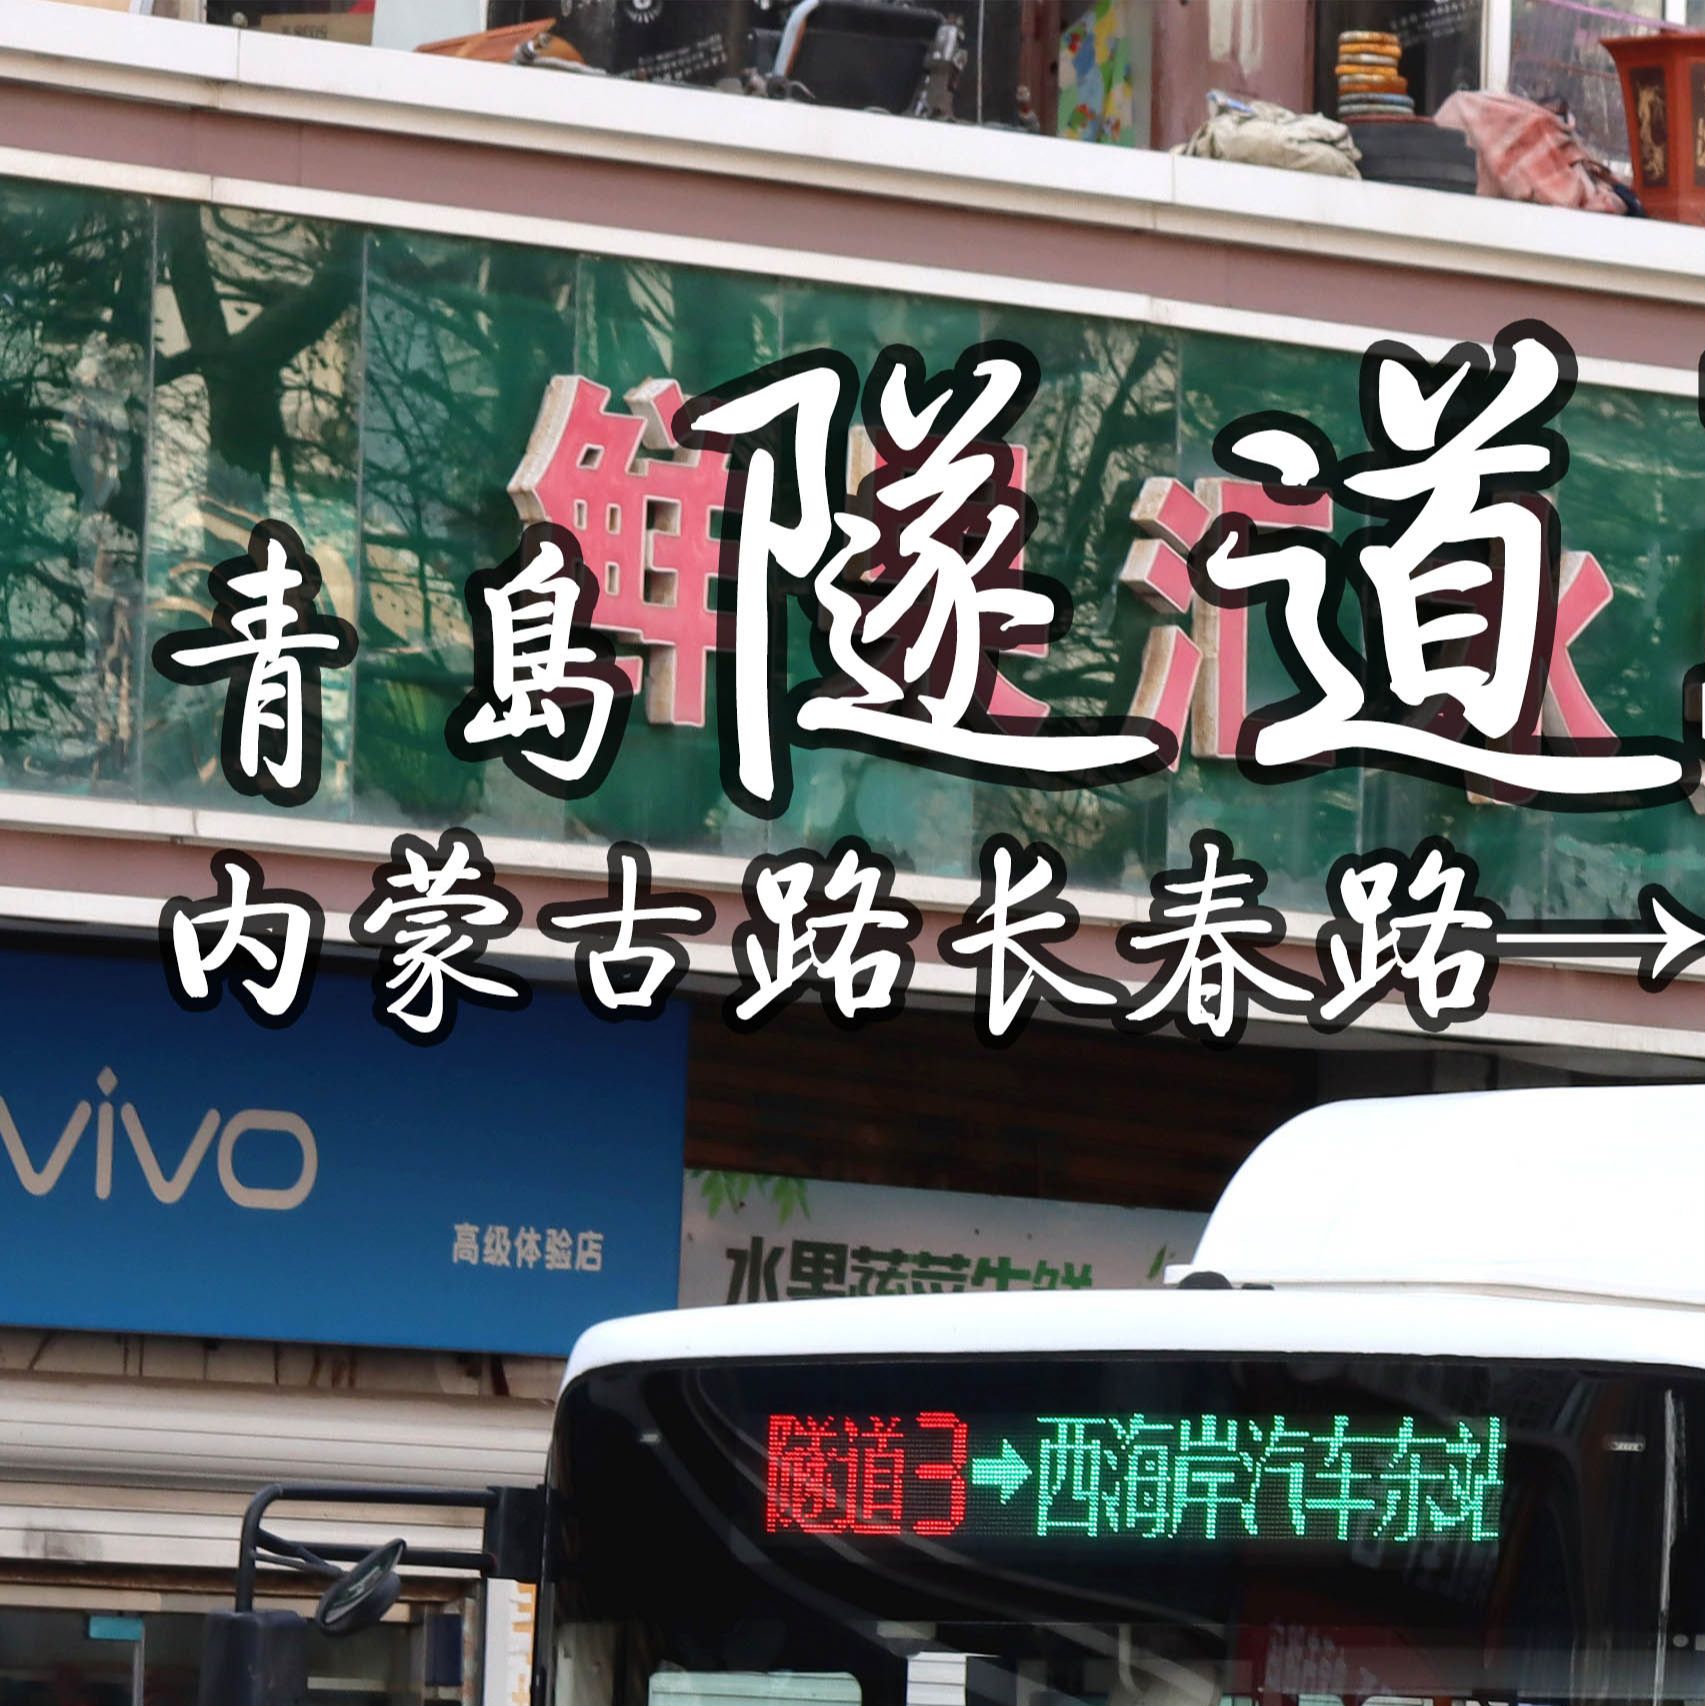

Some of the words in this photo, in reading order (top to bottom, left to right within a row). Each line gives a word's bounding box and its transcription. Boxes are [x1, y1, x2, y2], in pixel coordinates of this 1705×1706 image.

[0, 1066, 319, 1210] vivo
[452, 1222, 604, 1272] 高级体验店
[1036, 1411, 1506, 1542] 西海岸汽车东站
